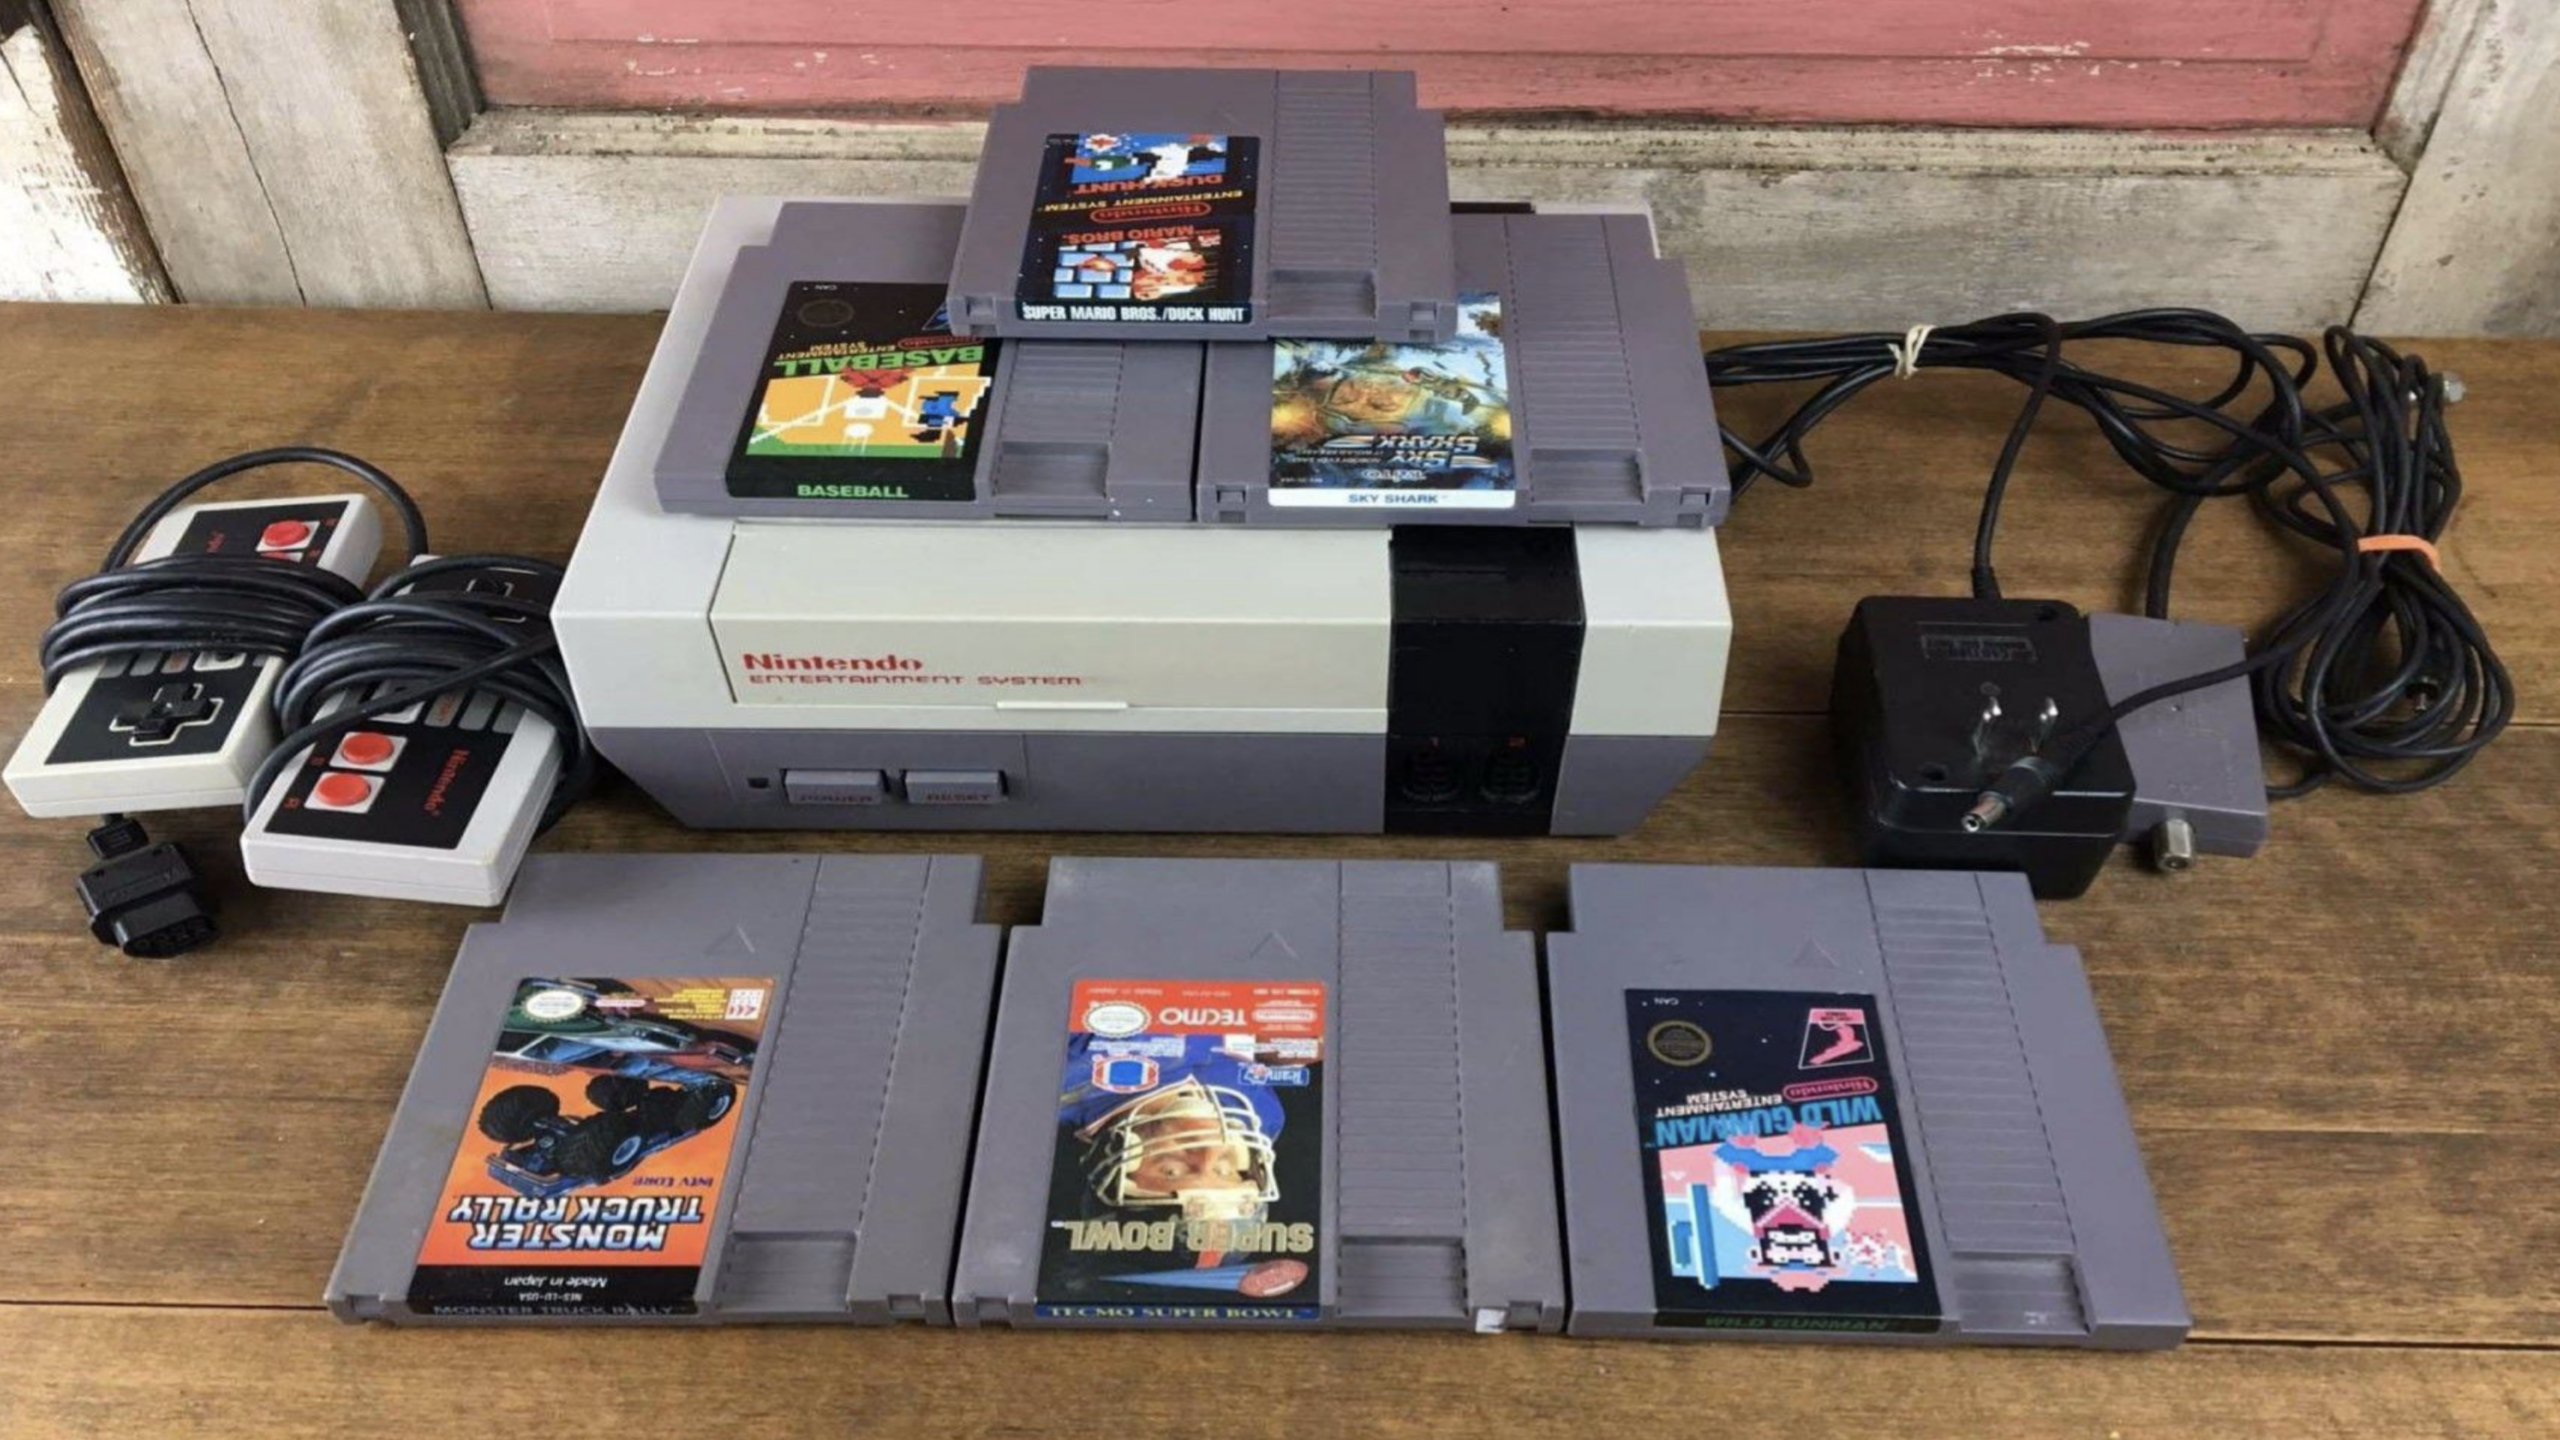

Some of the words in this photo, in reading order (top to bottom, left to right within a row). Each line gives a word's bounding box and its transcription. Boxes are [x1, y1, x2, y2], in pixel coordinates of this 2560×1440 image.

[1074, 180, 1145, 194] HUNT
[1044, 200, 1107, 212] SYSTEM
[1114, 189, 1244, 207] ENTERTAINMENT
[1099, 204, 1201, 219] Nintendo
[1127, 225, 1194, 241] MARIO
[1023, 305, 1066, 320] SUPER
[1070, 306, 1116, 320] MARIO
[1209, 306, 1244, 321] HUNT
[779, 345, 896, 360] ENTERTAINMENT
[810, 341, 866, 352] SYSTEM
[774, 346, 984, 376] BASEBALL
[1378, 435, 1479, 453] SHARK
[1388, 451, 1450, 468] SKY
[797, 484, 909, 498] BASEBALL
[1348, 493, 1380, 504] SKY
[1385, 493, 1439, 504] SHARK
[742, 653, 924, 671] Nintendo
[750, 674, 964, 685] ENTERTAINMENT
[978, 675, 1081, 686] SYSTEM
[424, 749, 470, 813] Nintendo
[926, 792, 991, 802] RESET
[1654, 996, 1679, 1005] CAN
[1160, 1008, 1246, 1027] TECMO
[1687, 1089, 1747, 1104] SYSTEM
[1791, 1081, 1870, 1098] Nintendo
[1655, 1094, 1782, 1118] ENTERTAINMENT
[1800, 1096, 1883, 1126] WILD
[1655, 1104, 1793, 1146] GUNMAN
[451, 1196, 565, 1222] RALLY
[575, 1196, 703, 1222] TRUCK
[470, 1224, 665, 1249] MONSTER
[1064, 1221, 1178, 1252] BOWL
[1186, 1221, 1314, 1252] SUPER
[504, 1276, 547, 1289] Japan
[551, 1277, 566, 1288] in
[567, 1277, 608, 1288] Made
[434, 1305, 534, 1314] MONSTER
[540, 1305, 606, 1314] TRUCK
[1051, 1306, 1135, 1317] TECMO
[1142, 1307, 1218, 1317] SUPER
[1227, 1308, 1295, 1318] BOWL
[1705, 1316, 1766, 1329] WILD
[1772, 1317, 1889, 1331] GUNMAN
